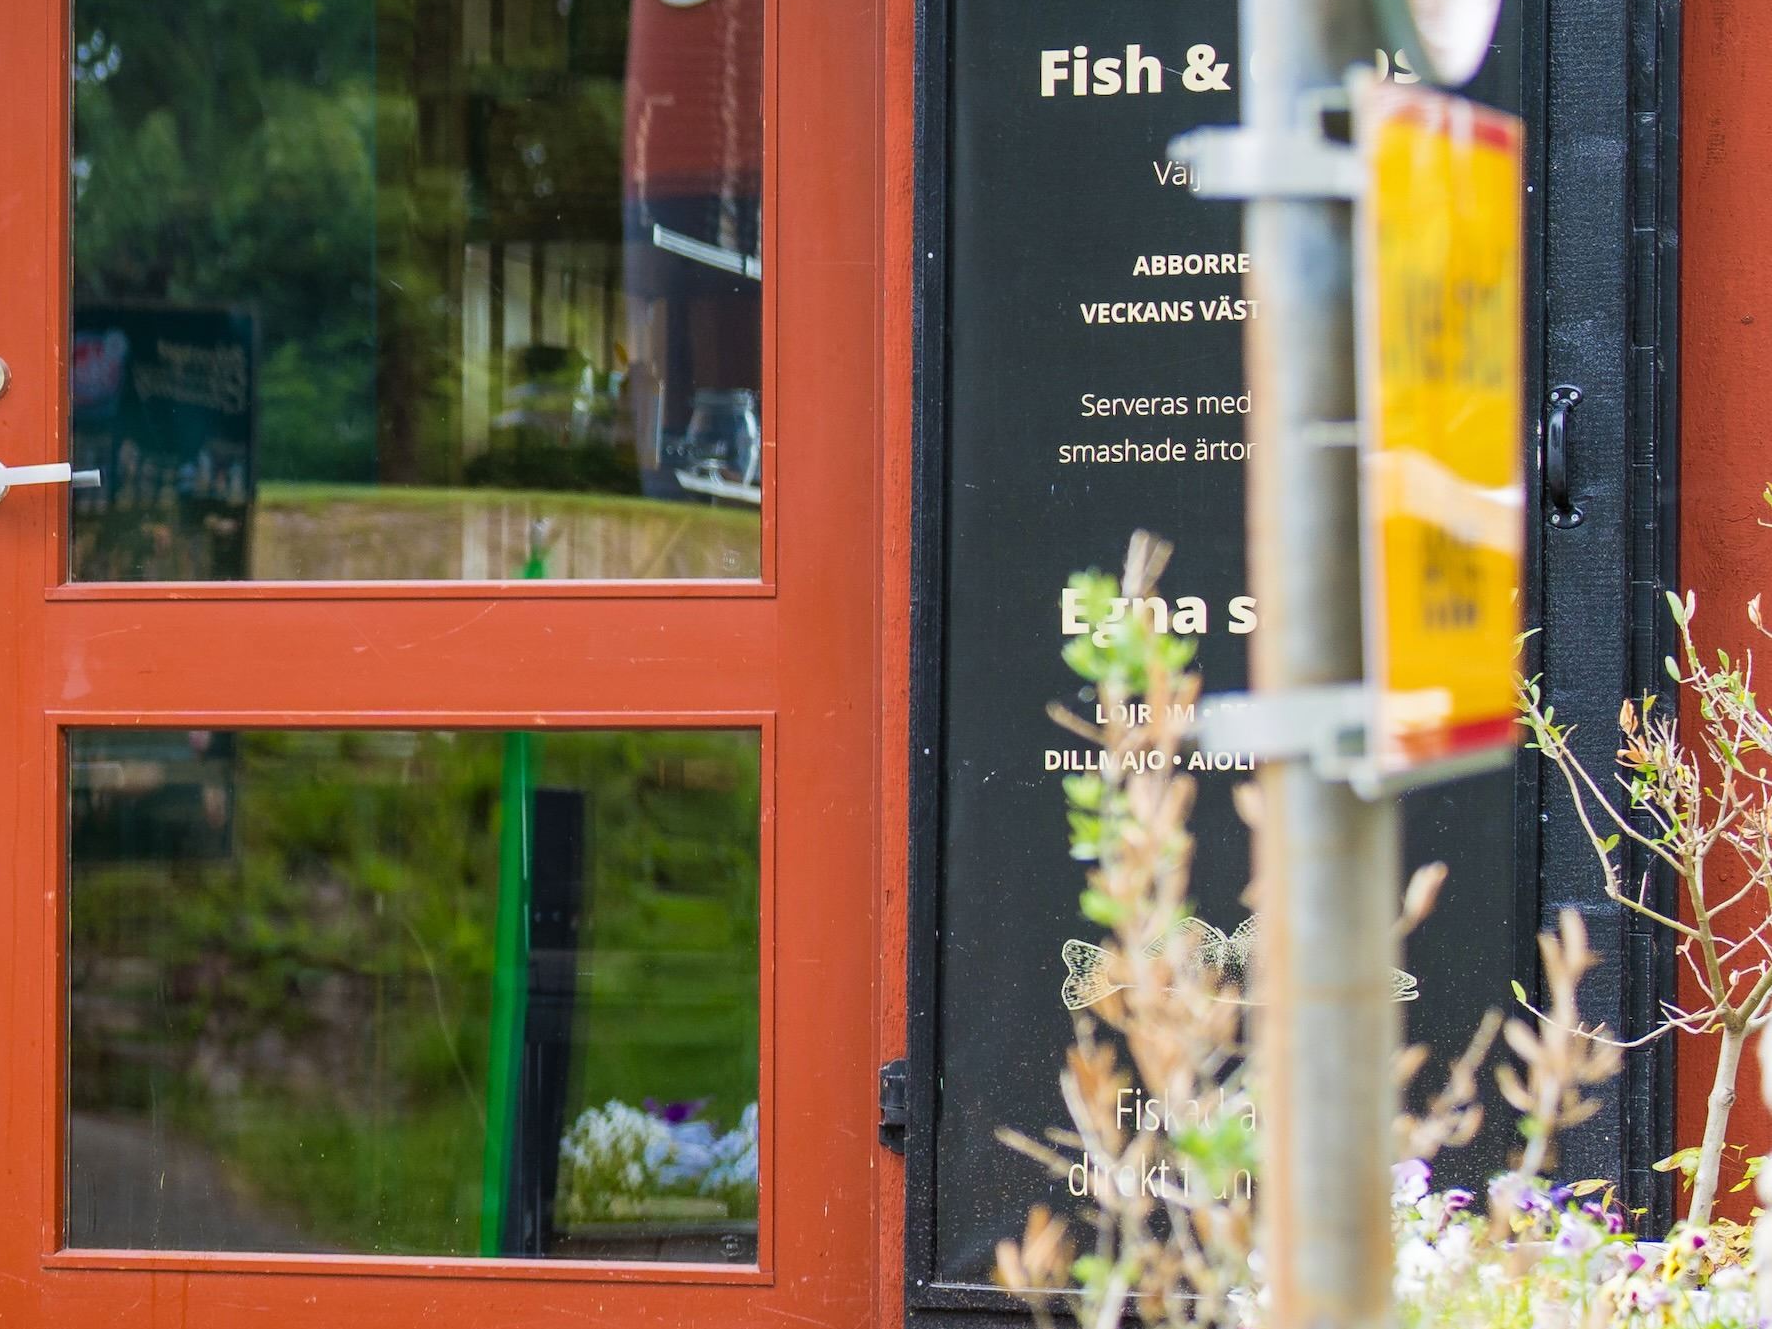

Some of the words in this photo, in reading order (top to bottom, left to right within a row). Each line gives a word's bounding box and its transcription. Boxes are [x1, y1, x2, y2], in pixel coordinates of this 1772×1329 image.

[1039, 42, 1163, 98] Fish
[1180, 40, 1232, 94] &
[1132, 252, 1251, 277] ABBORRE
[1079, 300, 1194, 325] VECKANS
[1079, 393, 1189, 419] Serveras
[1195, 390, 1252, 416] med
[1057, 437, 1187, 466] smashade
